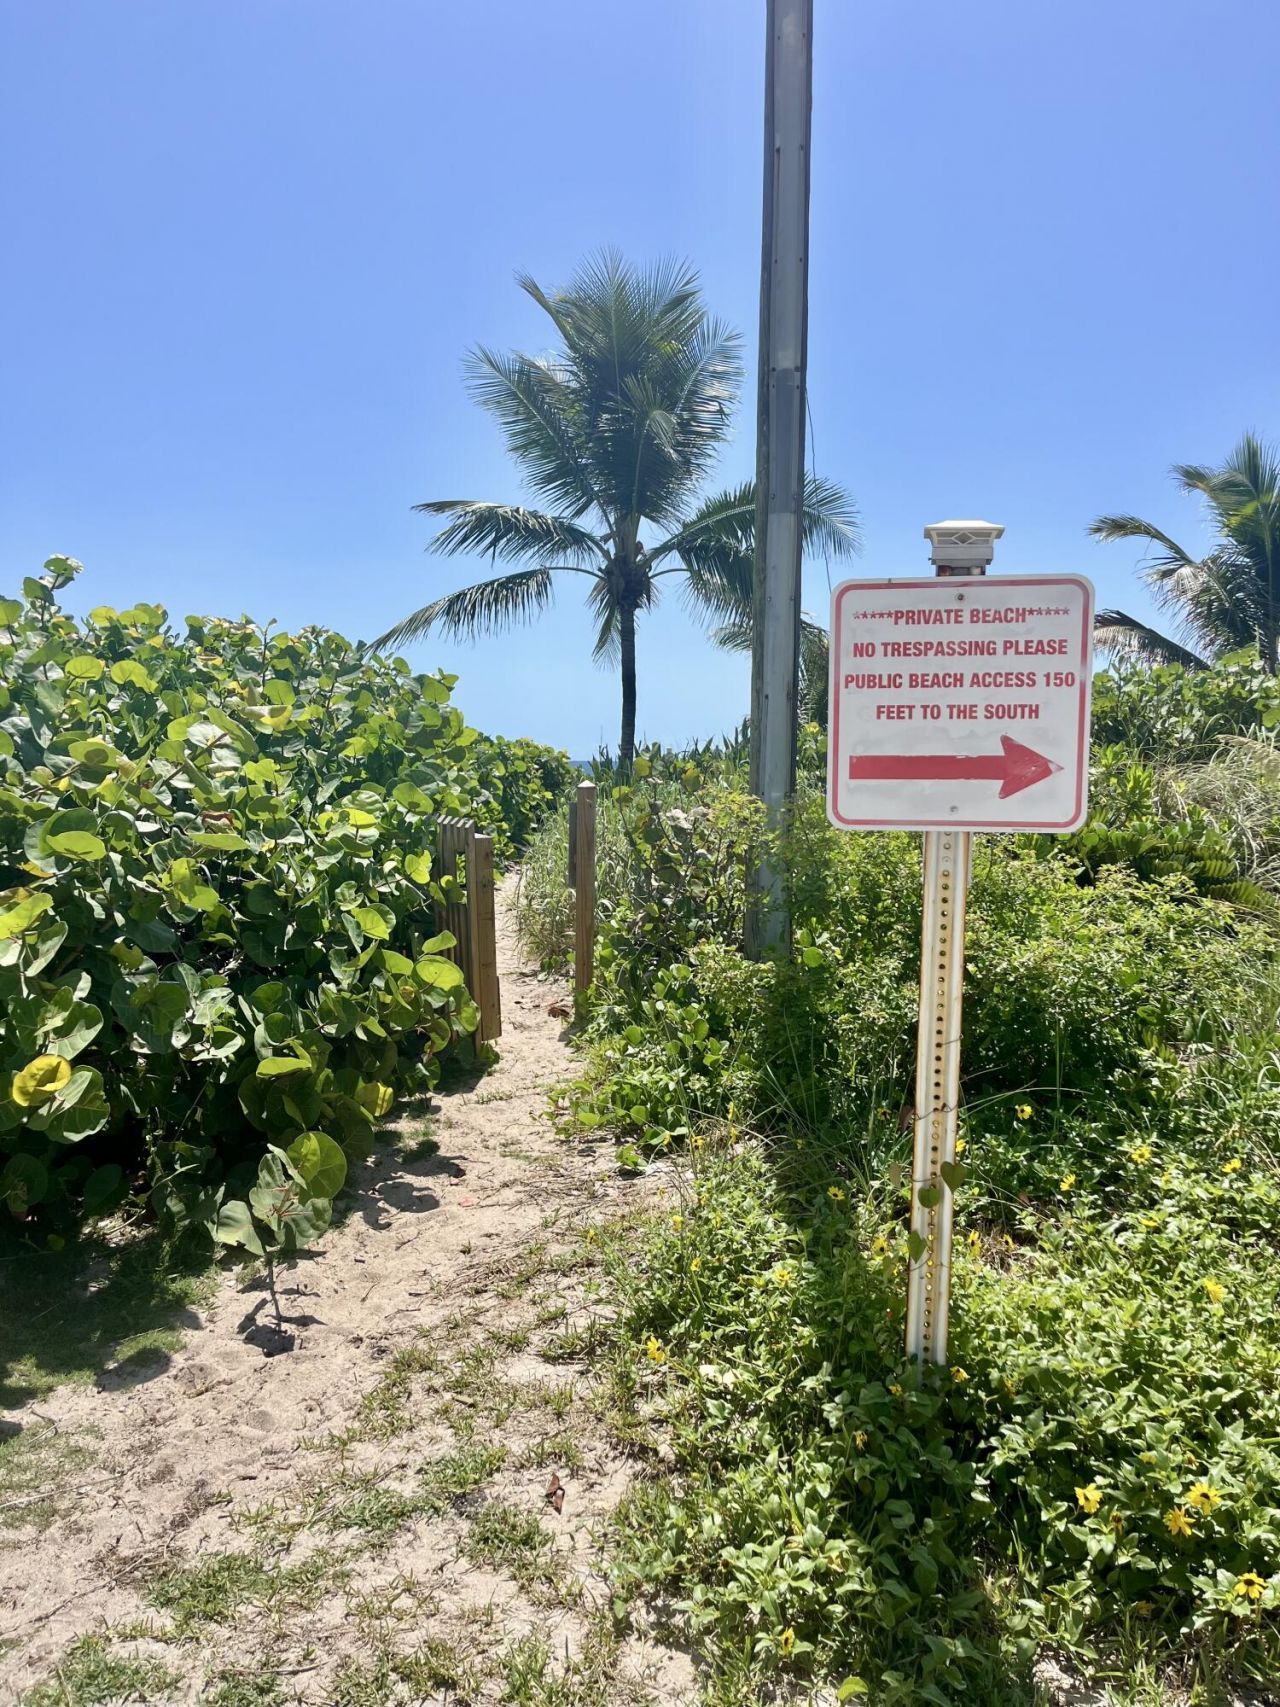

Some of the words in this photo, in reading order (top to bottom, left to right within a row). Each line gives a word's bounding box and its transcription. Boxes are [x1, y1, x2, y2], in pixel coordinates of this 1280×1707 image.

[894, 608, 964, 625] PRIVATE
[970, 607, 1026, 624] BEACH
[853, 642, 876, 658] NO
[881, 640, 997, 657] TRESPASSING
[1003, 639, 1068, 656] PLEASE
[844, 673, 903, 689] PUBLIC
[908, 672, 964, 688] BEACH
[970, 672, 1037, 688] ACCESS
[1043, 671, 1076, 687] 150
[876, 704, 915, 720] FEET
[920, 704, 941, 720] TO
[946, 704, 978, 719] THE
[983, 703, 1040, 719] SOUTH
